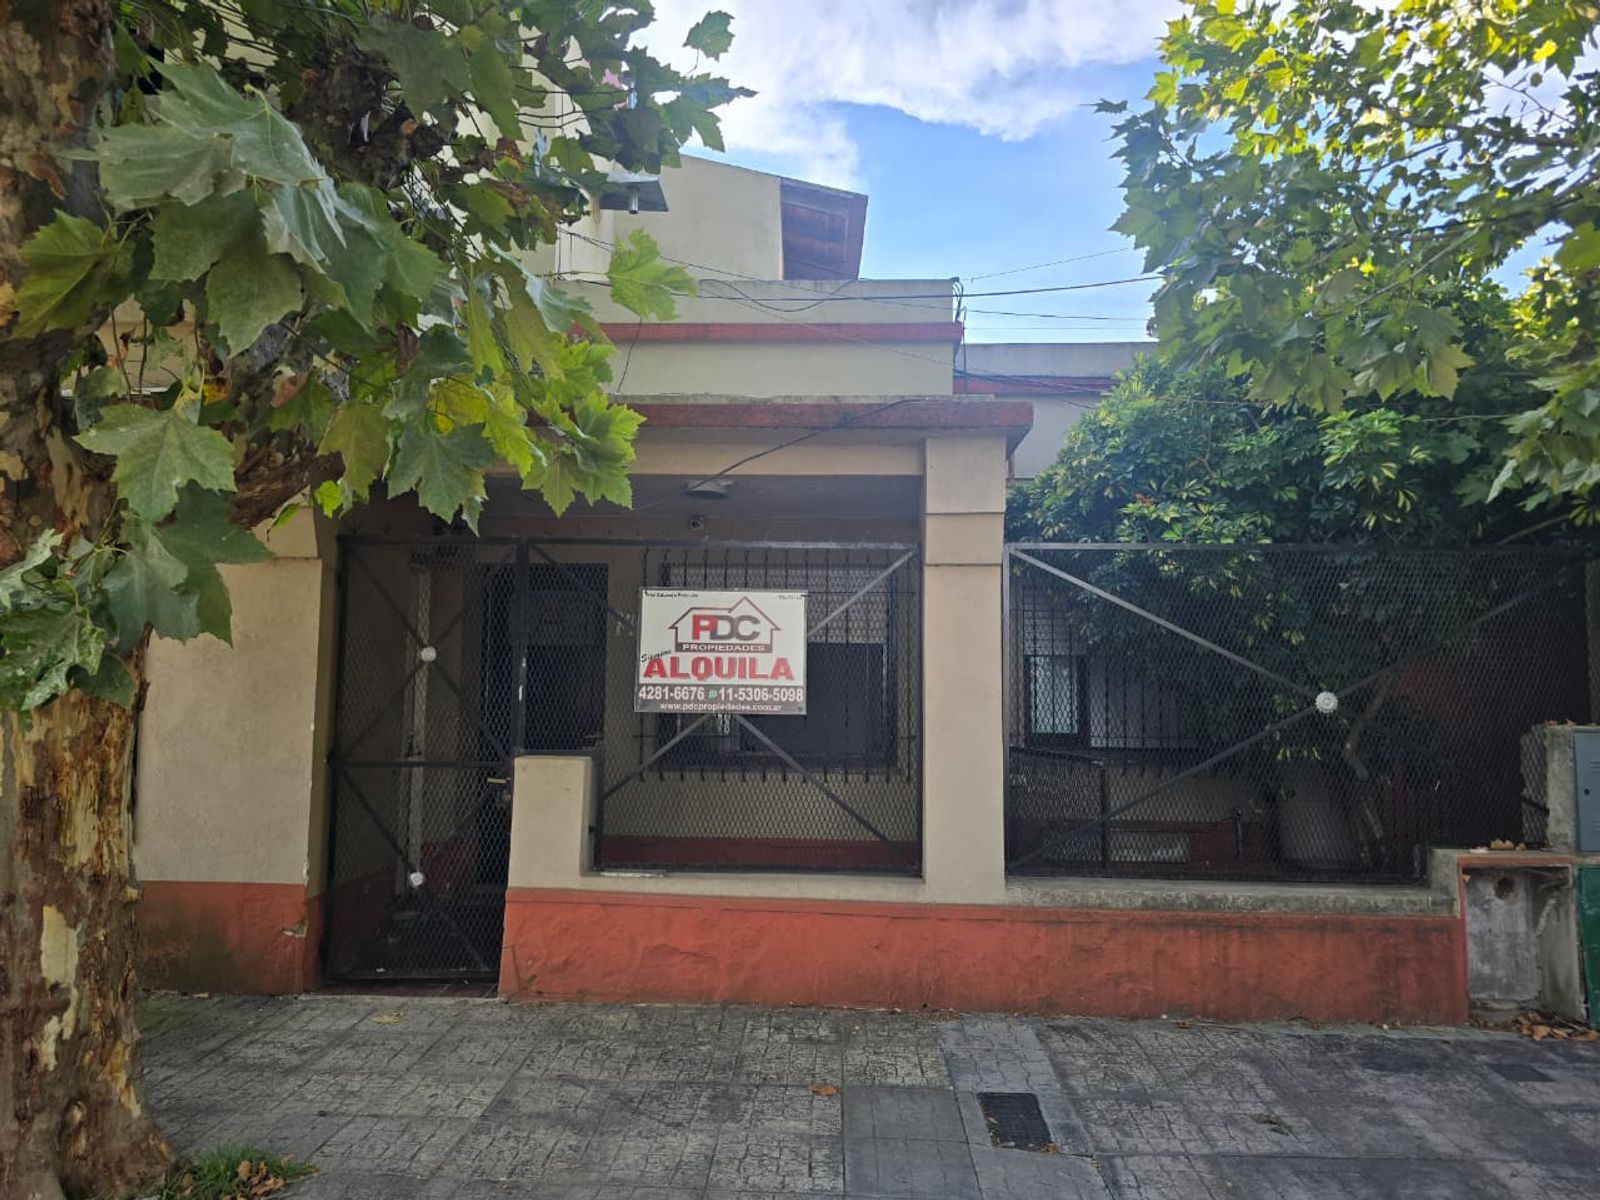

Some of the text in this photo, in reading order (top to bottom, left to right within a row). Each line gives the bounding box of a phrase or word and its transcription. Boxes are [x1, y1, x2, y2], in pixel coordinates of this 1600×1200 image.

[692, 614, 761, 641] PDC
[682, 643, 766, 651] PROPIEDADES
[643, 656, 795, 682] ALQUILA
[638, 686, 705, 701] 4281-6676
